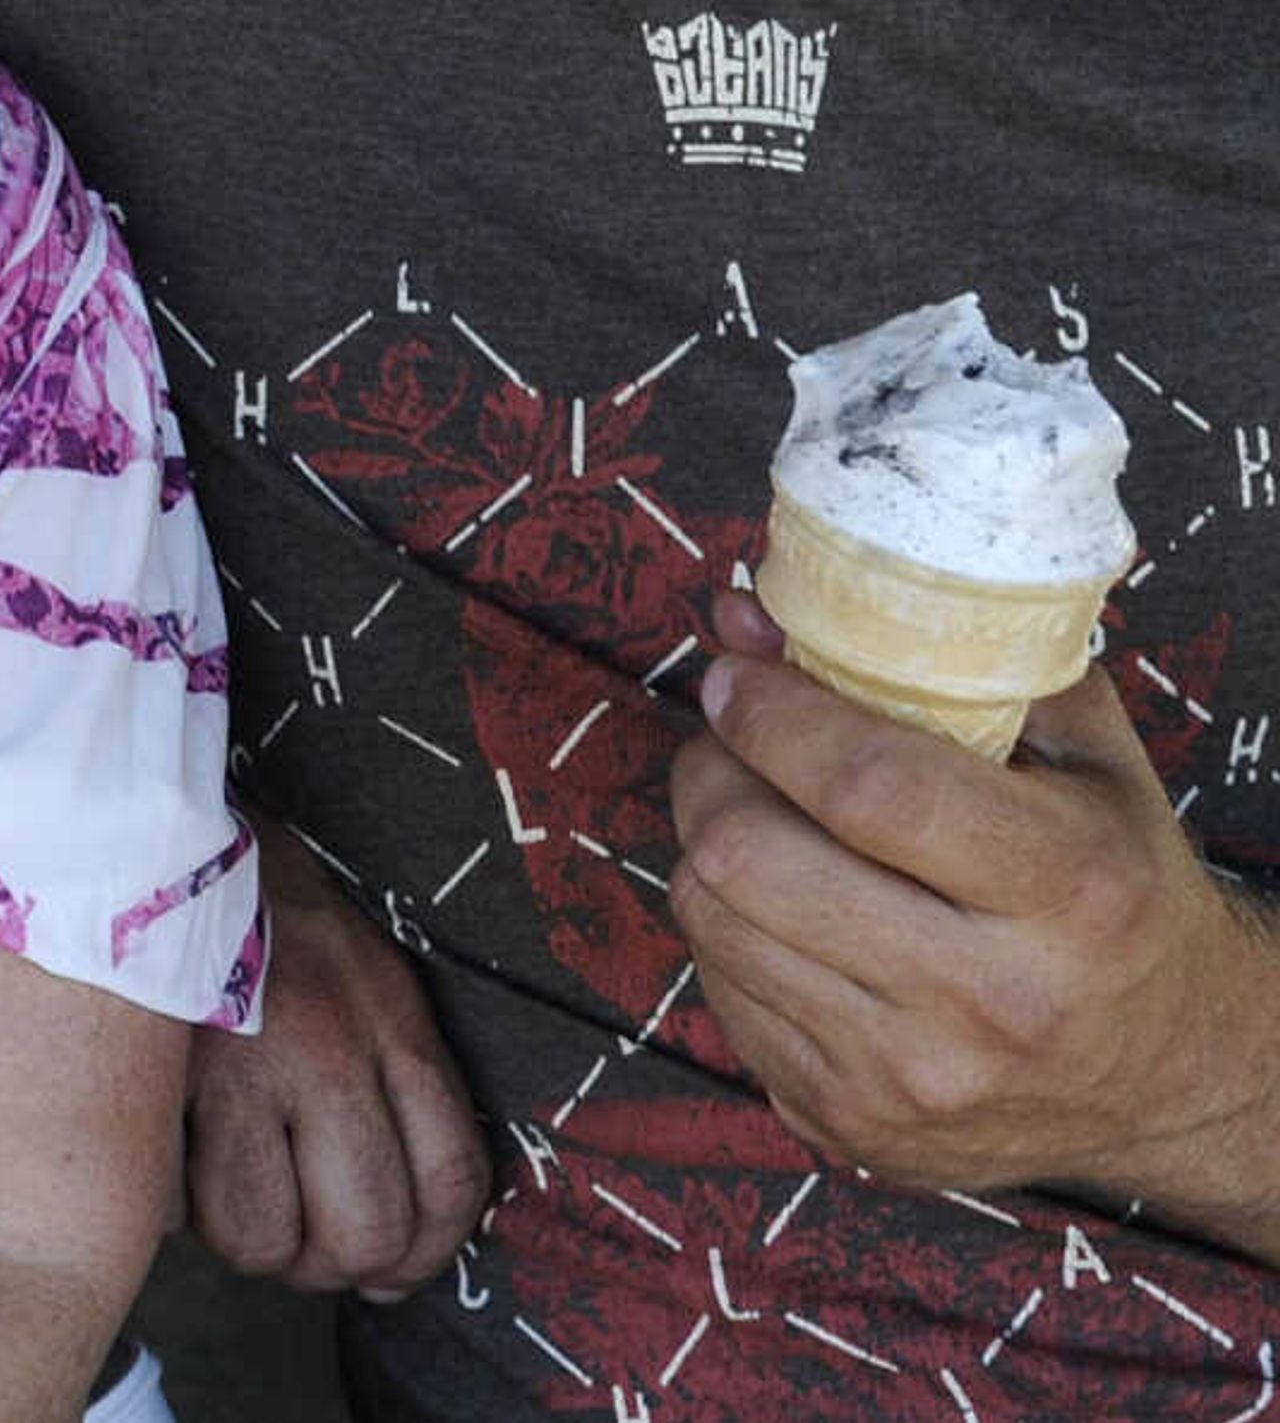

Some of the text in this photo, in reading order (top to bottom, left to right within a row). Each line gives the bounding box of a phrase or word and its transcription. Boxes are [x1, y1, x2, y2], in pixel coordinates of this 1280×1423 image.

[397, 261, 430, 313] L
[717, 261, 758, 338] A
[234, 370, 268, 445] H
[302, 636, 342, 705] H
[496, 768, 547, 843] L
[709, 1248, 759, 1320] L
[1064, 1224, 1111, 1289] A
